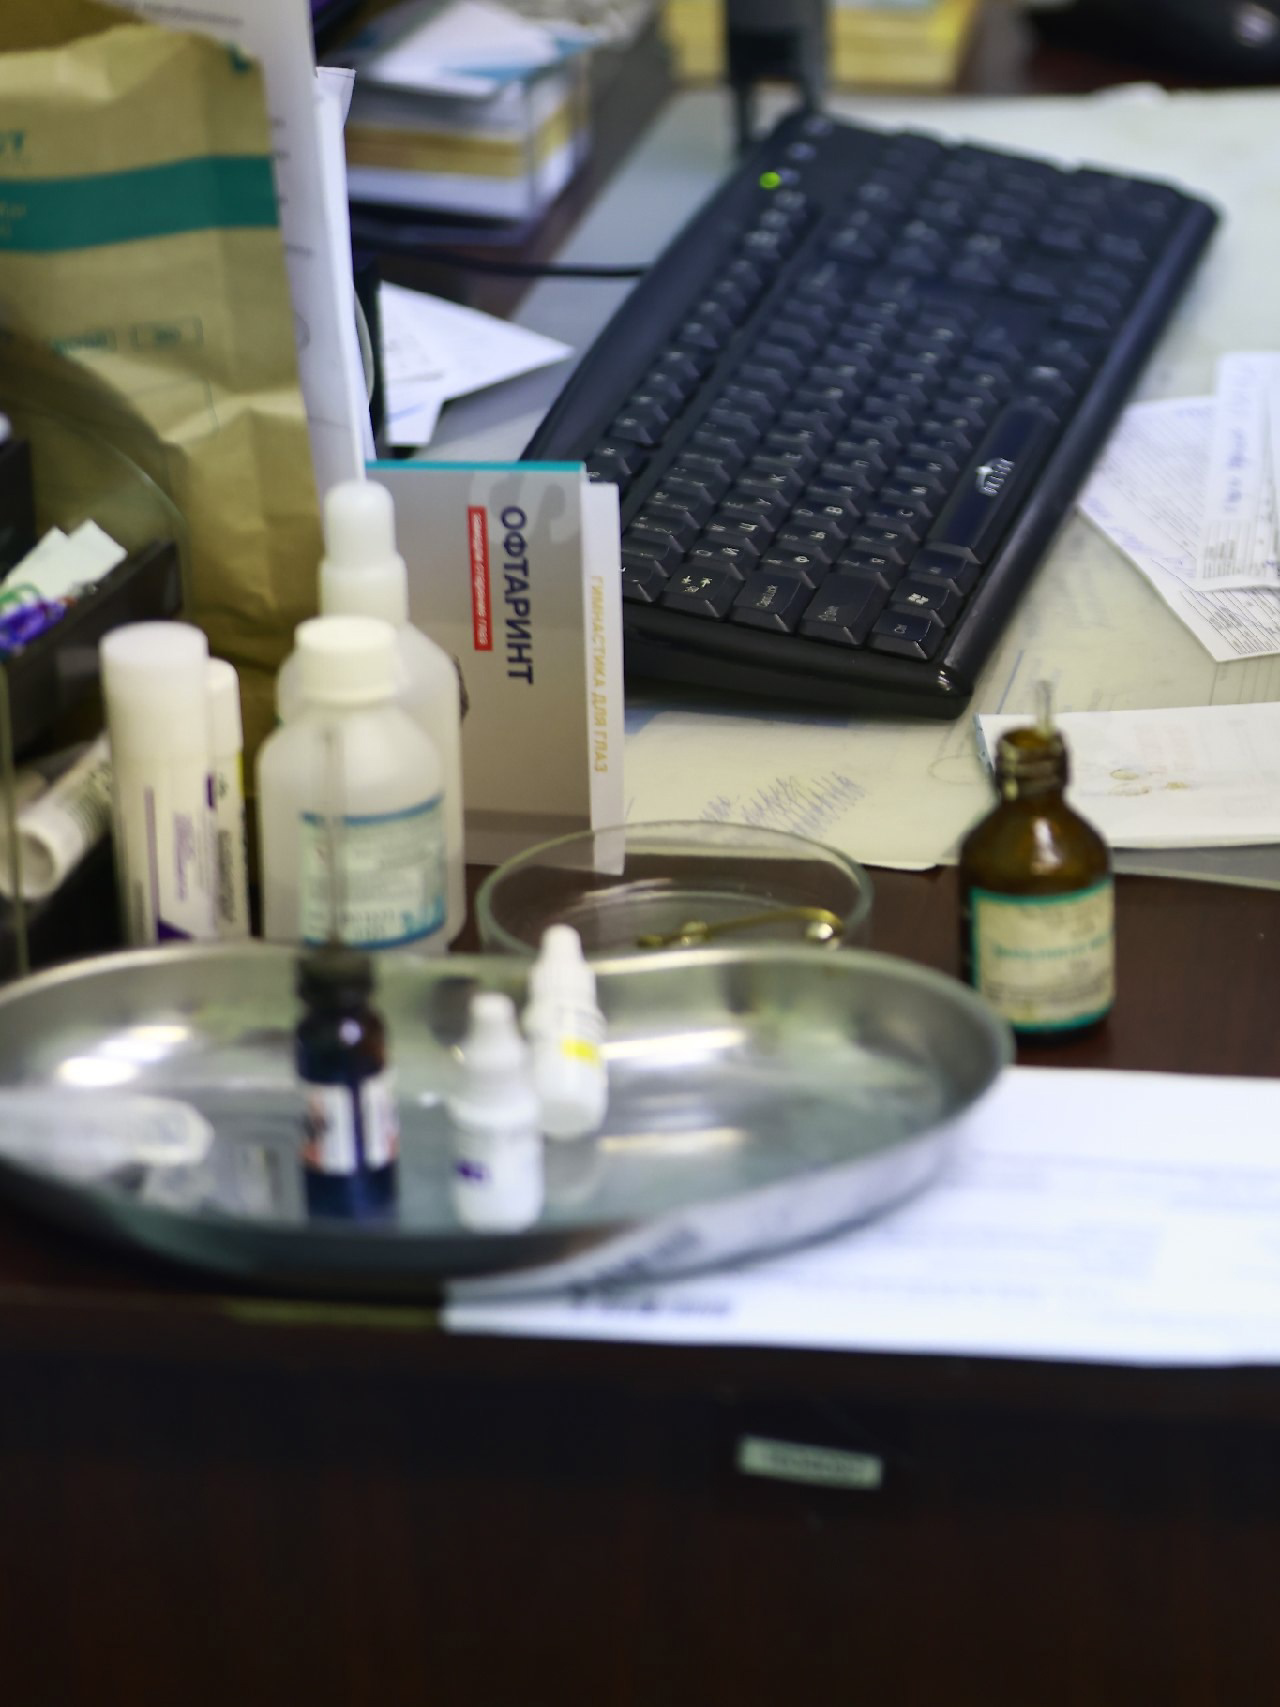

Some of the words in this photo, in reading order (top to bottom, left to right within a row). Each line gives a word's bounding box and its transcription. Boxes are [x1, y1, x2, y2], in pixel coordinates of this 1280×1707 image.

[500, 505, 534, 685] ОФТАРИНТ
[590, 575, 607, 687] ГИМНАСТИКА
[592, 691, 608, 727] ДЛЯ
[593, 730, 609, 773] ГЛАЗ
